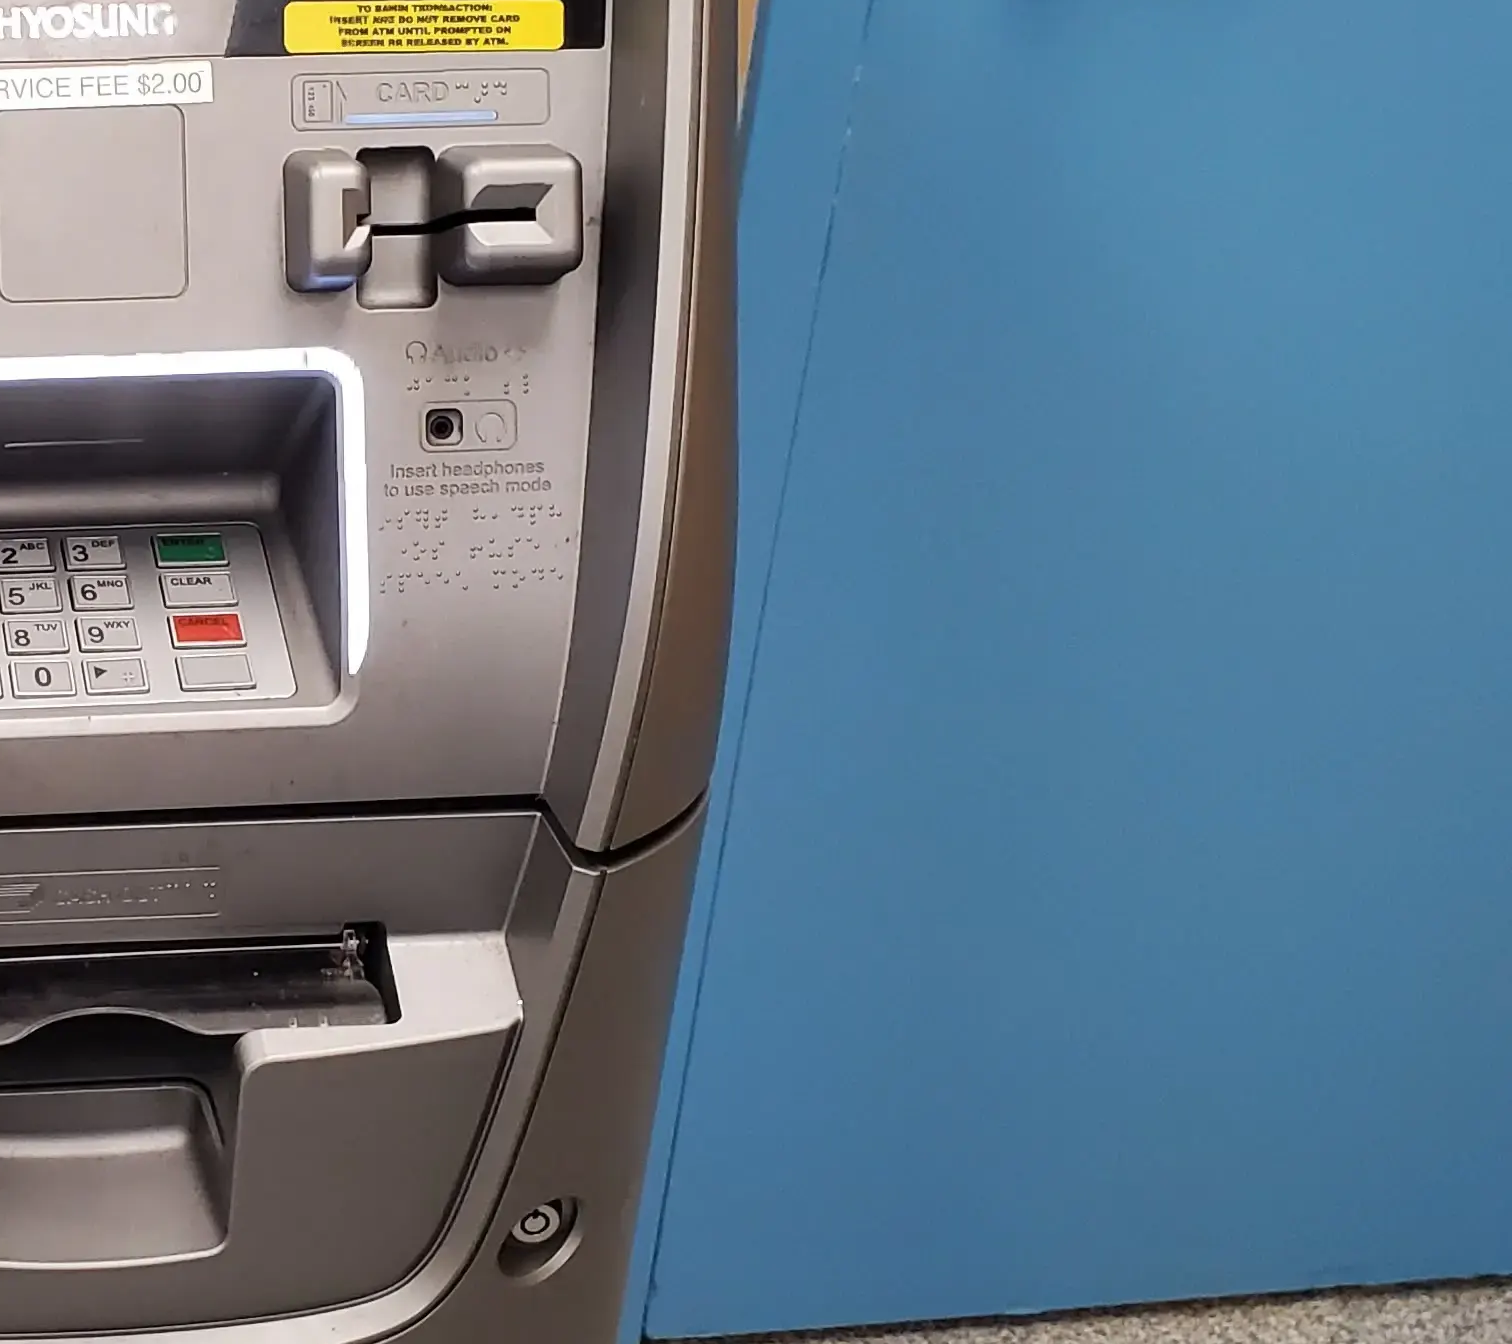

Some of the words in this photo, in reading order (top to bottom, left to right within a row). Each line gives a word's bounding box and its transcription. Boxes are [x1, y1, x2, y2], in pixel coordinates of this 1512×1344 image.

[357, 5, 371, 13] TO
[398, 16, 413, 24] DO
[443, 15, 487, 23] REMOVE
[491, 14, 520, 23] CARD
[338, 27, 368, 36] FROM
[373, 27, 394, 35] ATM
[434, 26, 492, 35] PROMPTED
[496, 26, 511, 34] ON
[407, 38, 462, 47] RELEASED
[465, 38, 480, 46] BY
[483, 37, 509, 46] ATM.
[80, 74, 129, 97] FEE
[138, 71, 202, 96] $2.00
[376, 81, 449, 103] CARD
[433, 344, 498, 364] Audio
[390, 463, 438, 479] Insert
[442, 461, 545, 480] headphones
[384, 483, 399, 497] to
[405, 484, 434, 496] use
[440, 479, 500, 498] speech
[506, 477, 552, 494] mode
[1, 547, 18, 564] 2
[19, 542, 45, 550] ABC
[71, 544, 89, 562] 3
[91, 540, 116, 548] DEF
[80, 583, 97, 601] 6
[97, 579, 123, 588] MNO
[170, 576, 212, 586] CLEAR
[8, 587, 25, 605] 5
[28, 582, 52, 591] JKL
[14, 629, 31, 647] 8
[34, 623, 58, 632] TUV
[88, 625, 105, 643] 9
[103, 620, 130, 629] WXY
[34, 666, 52, 687] 0
